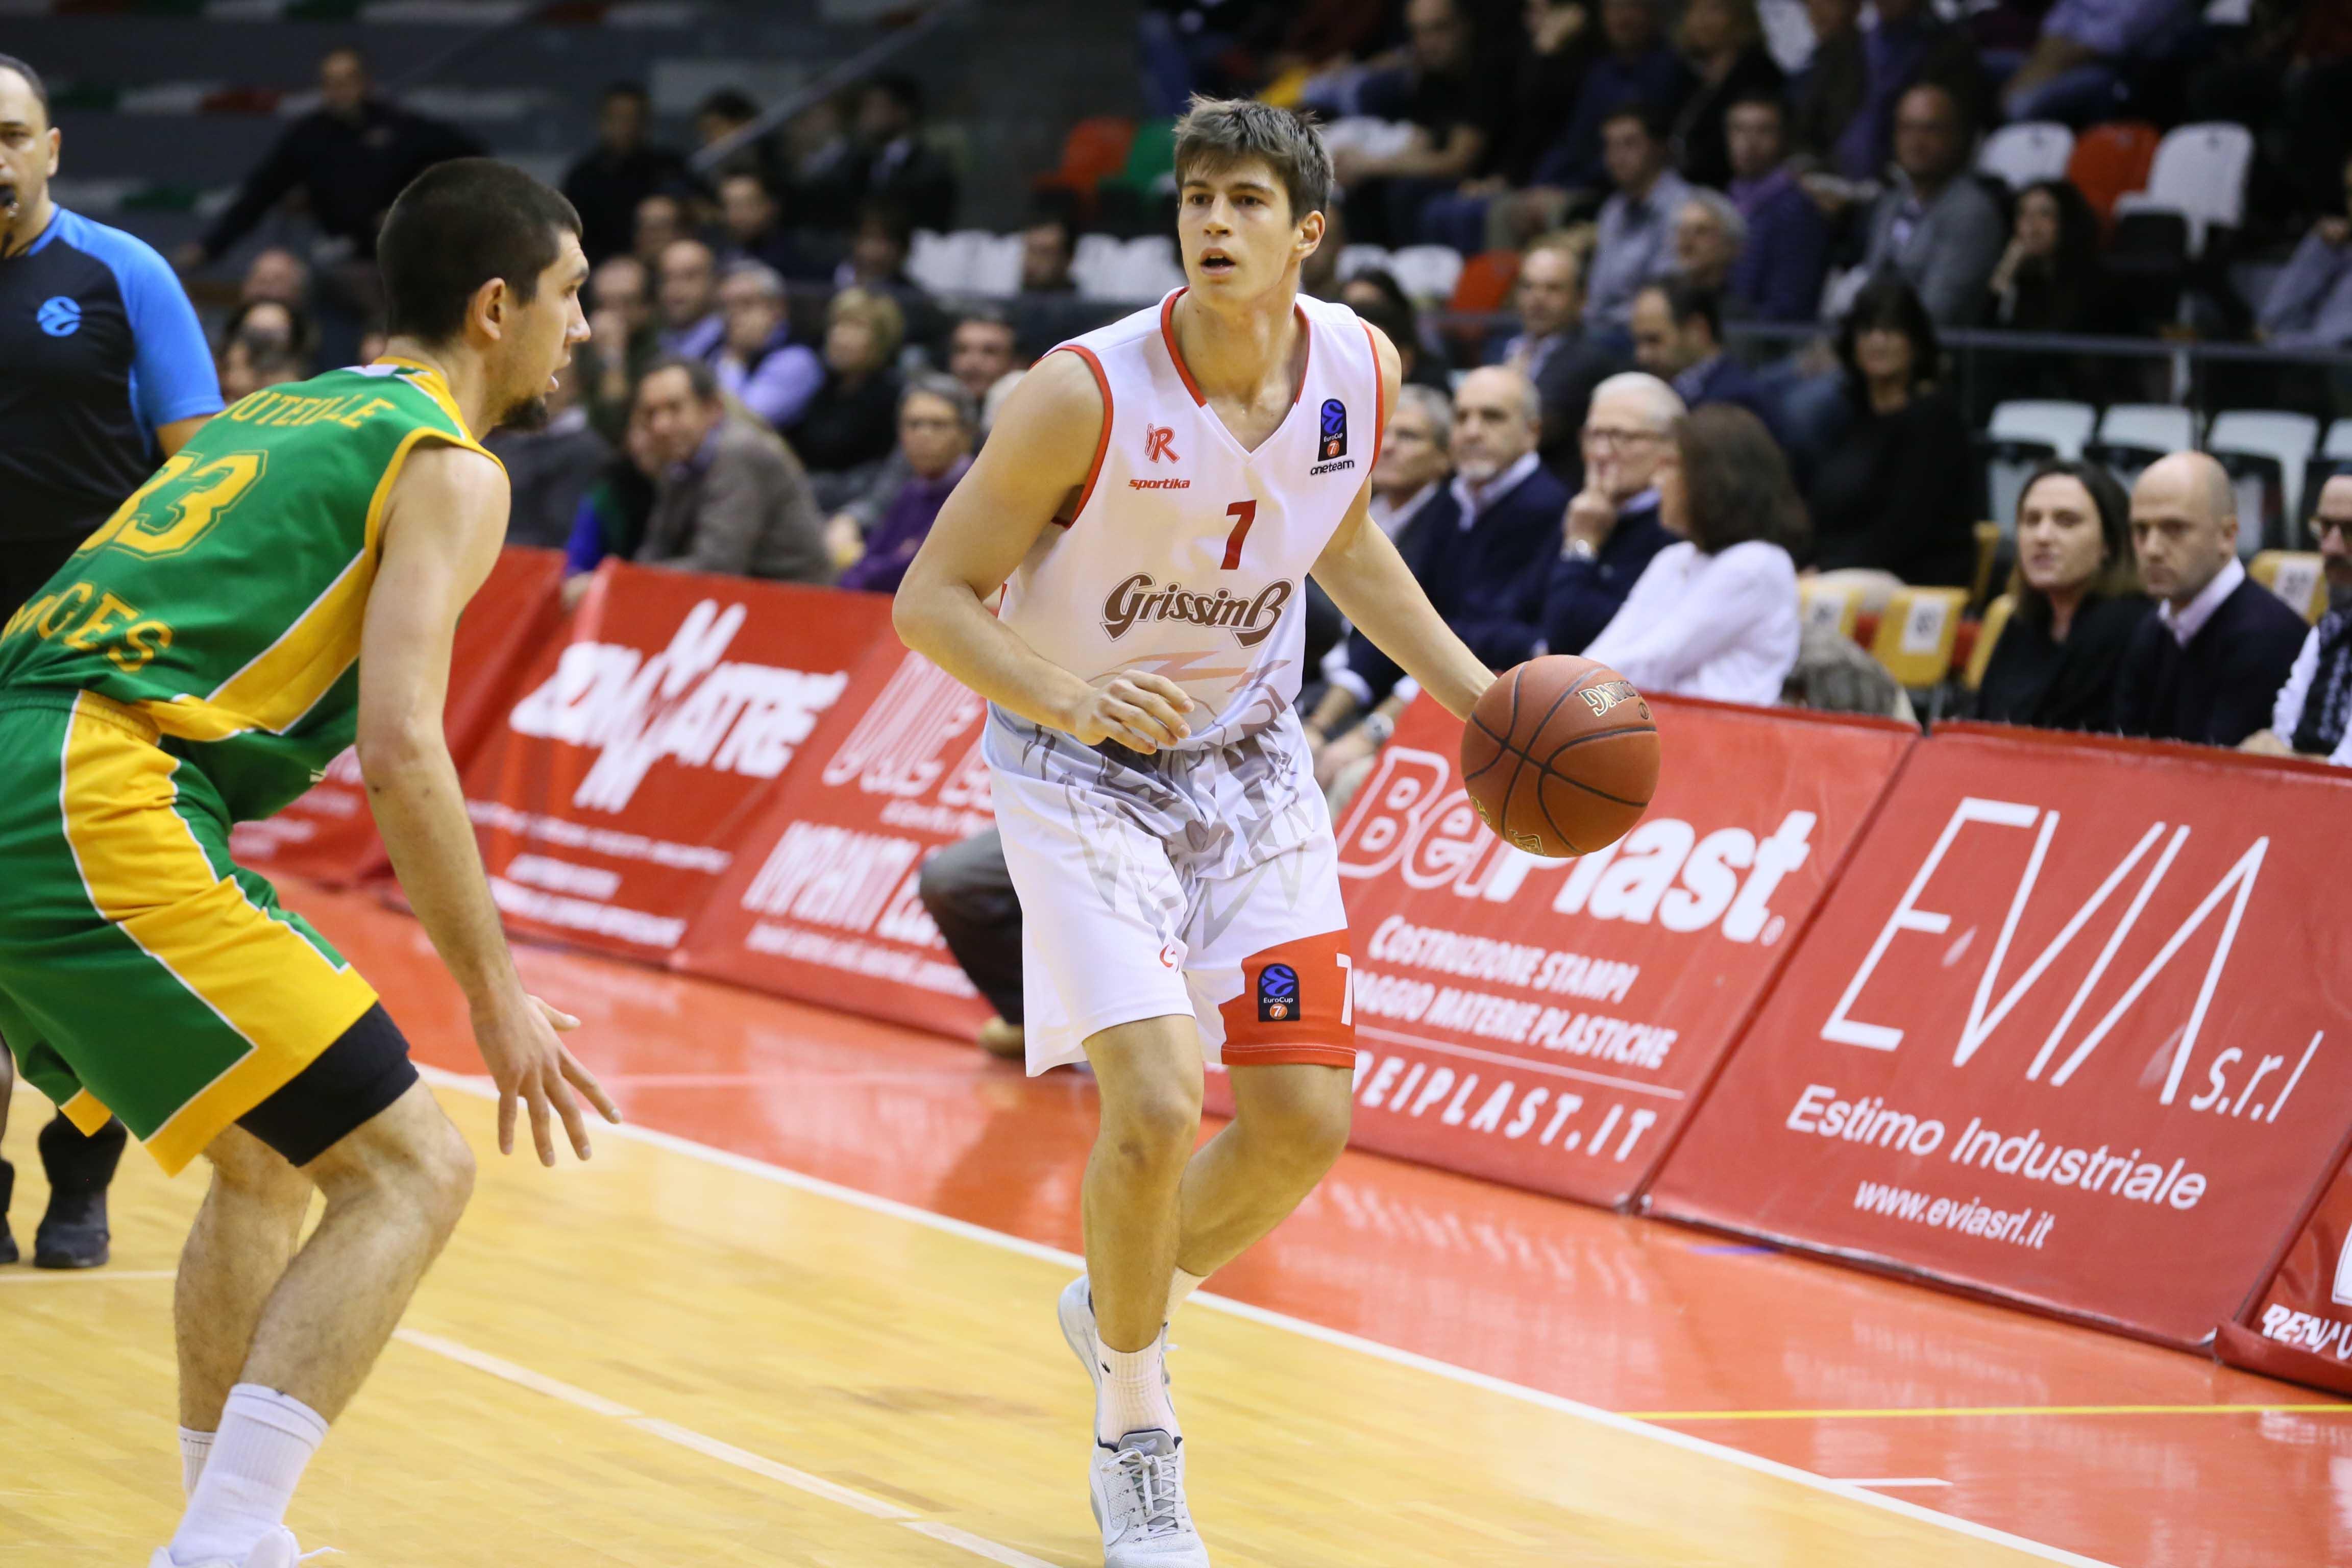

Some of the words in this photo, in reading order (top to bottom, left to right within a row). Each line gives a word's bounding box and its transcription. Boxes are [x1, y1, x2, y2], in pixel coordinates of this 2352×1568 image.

[1324, 433, 1343, 442] EuroCup
[1128, 479, 1190, 490] sportika
[1220, 500, 1256, 570] 7
[1533, 951, 1639, 1004] STAMPI
[1821, 796, 2269, 1105] EVIA
[1424, 987, 1541, 1043] MATERIE
[1527, 1007, 1678, 1069] PLASTICHE
[1786, 1084, 1945, 1156] Estimo
[1950, 1117, 2207, 1209] Industriale
[1853, 1181, 2055, 1250] www.eviasrl.it
